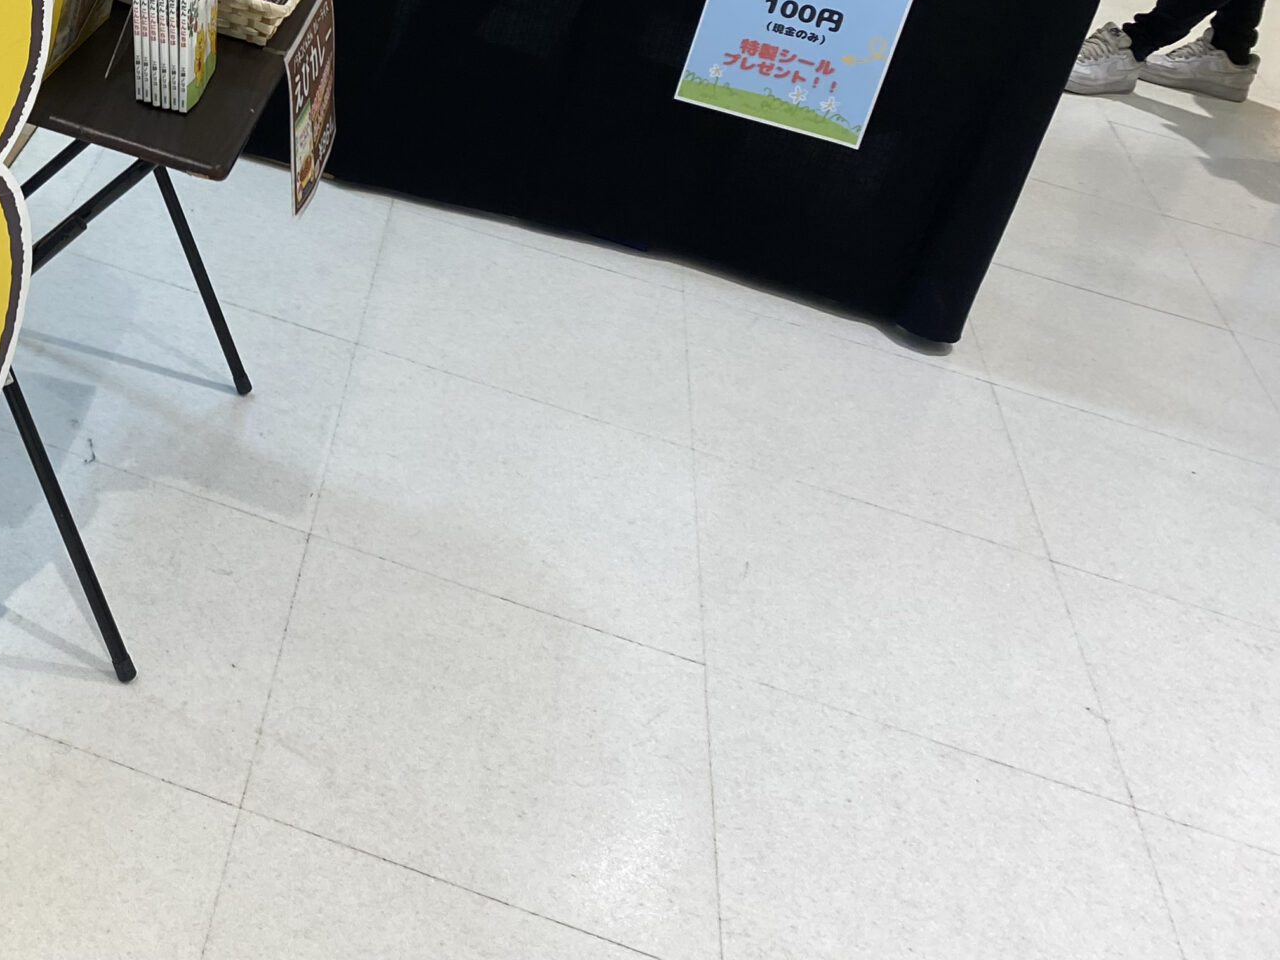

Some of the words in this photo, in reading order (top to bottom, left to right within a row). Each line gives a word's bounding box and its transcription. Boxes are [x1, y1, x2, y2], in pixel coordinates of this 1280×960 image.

[739, 38, 835, 76] 特製シール
